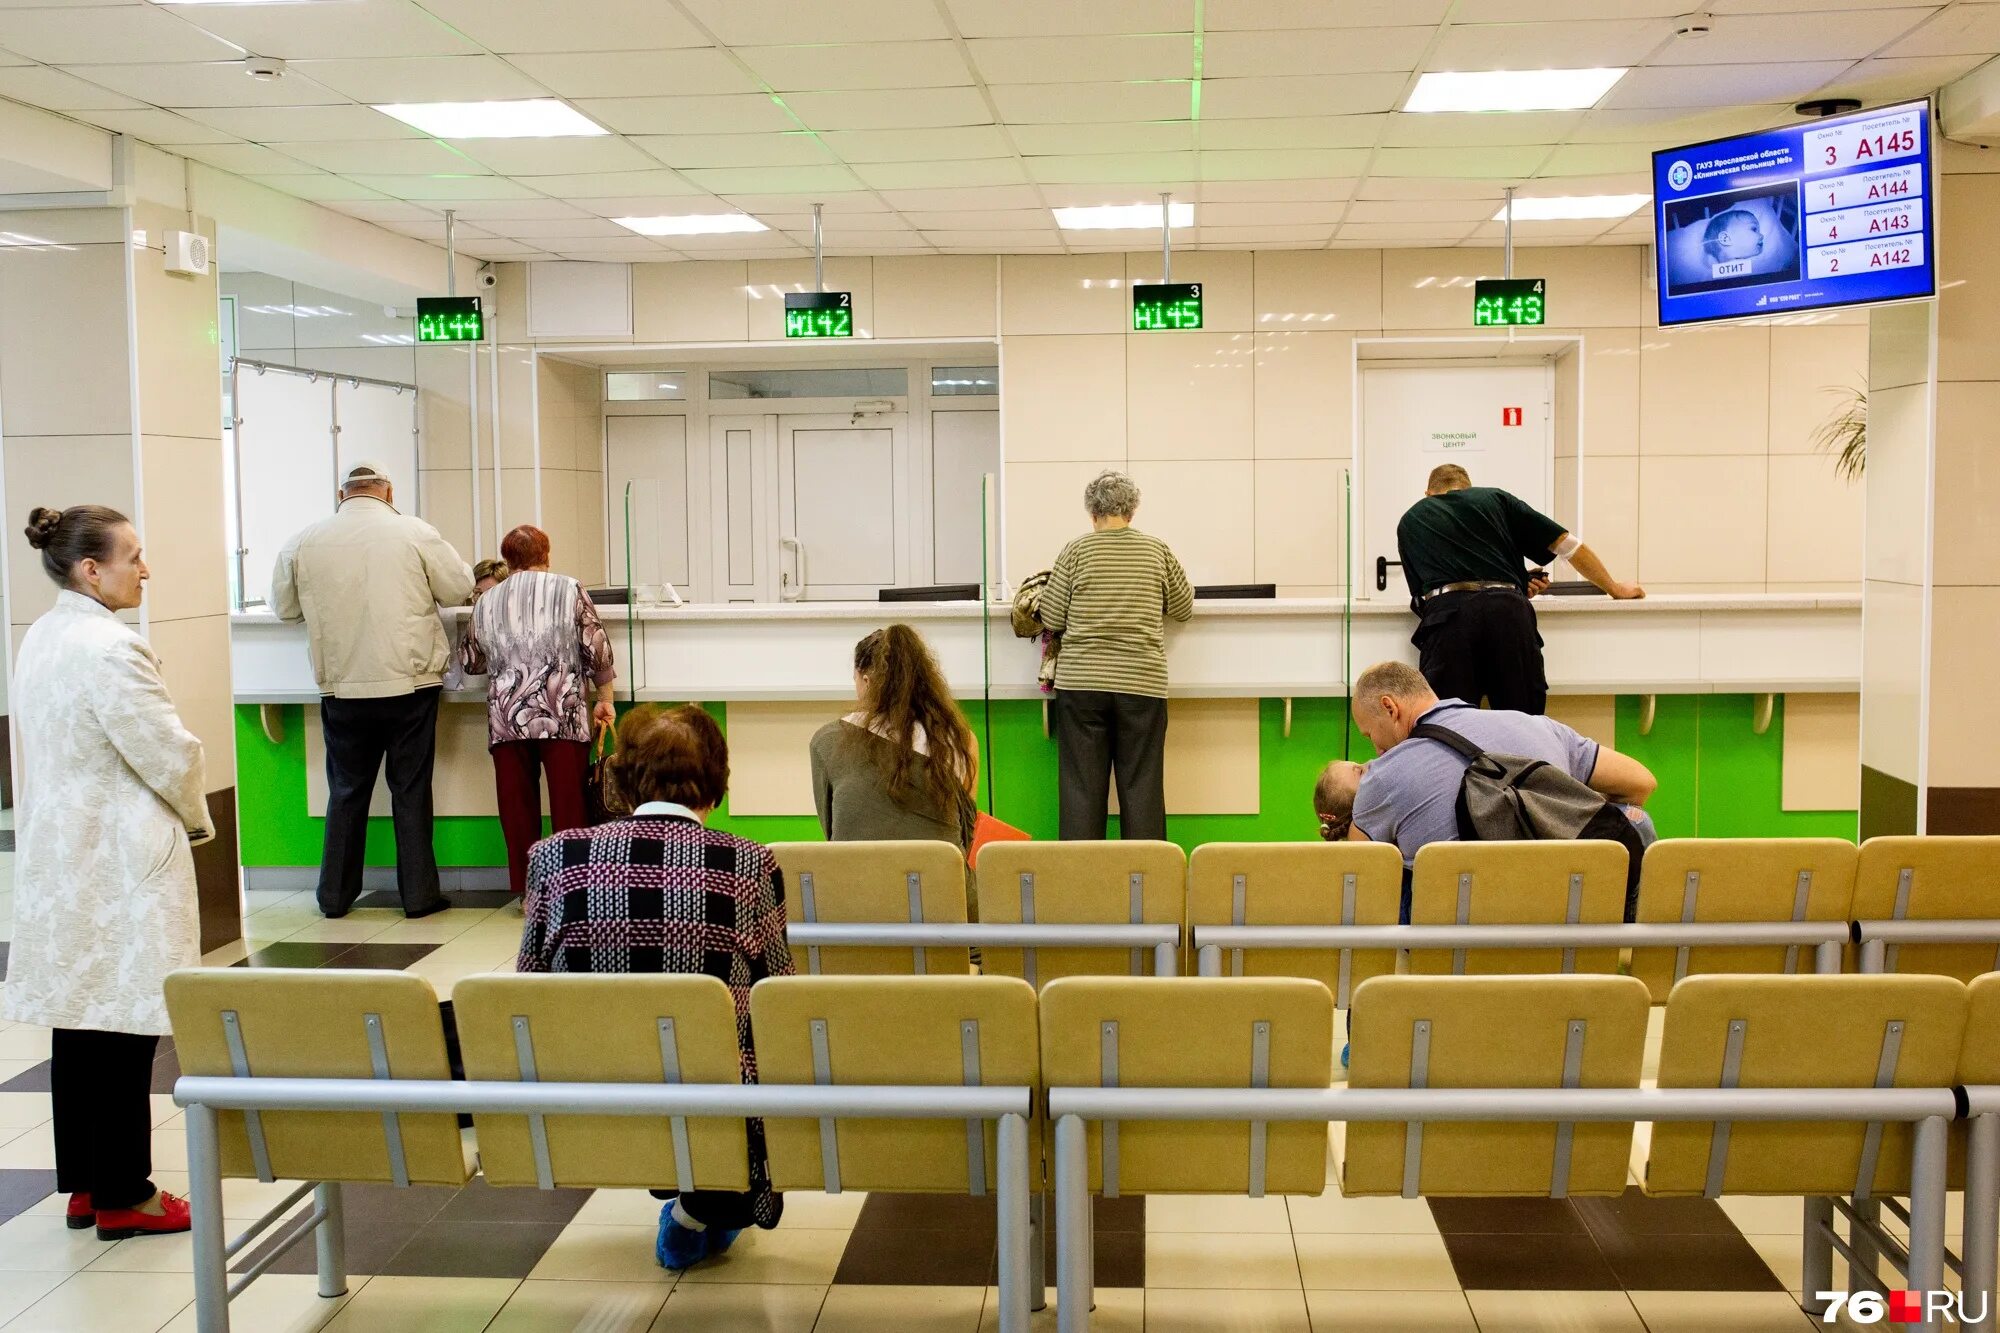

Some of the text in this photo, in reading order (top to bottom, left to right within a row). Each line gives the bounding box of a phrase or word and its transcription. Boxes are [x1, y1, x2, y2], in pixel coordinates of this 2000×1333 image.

[1825, 130, 1914, 166] 3 A145
[1696, 148, 1790, 171] ГАУЗ Ярославской области
[1741, 160, 1776, 172] больница
[1828, 179, 1908, 206] 1 A144
[1829, 214, 1909, 239] 4 A143
[1830, 249, 1910, 272] 2 A142
[1718, 263, 1744, 274] ОТИТ
[1190, 285, 1200, 298] 3
[1533, 280, 1543, 293] 4
[471, 298, 479, 311] 1
[840, 294, 849, 306] 2
[1431, 431, 1477, 440] ЗВОНКОВЫЙ
